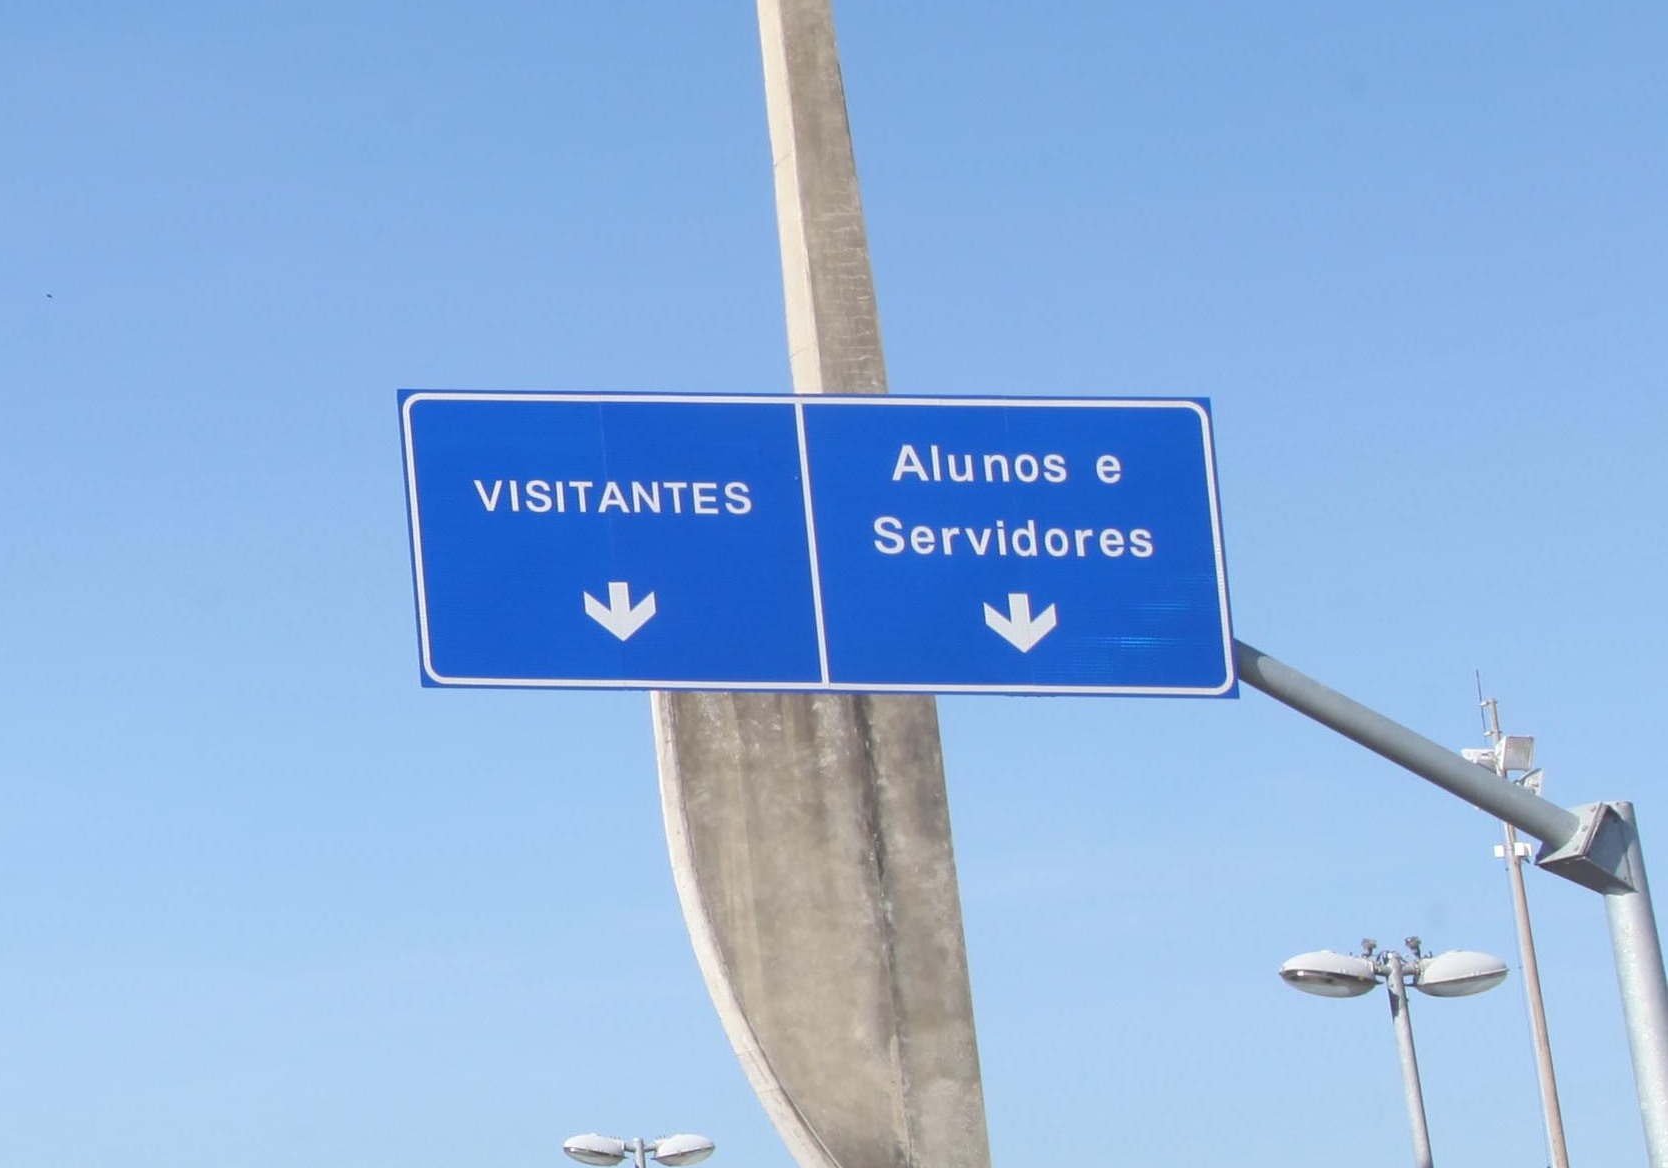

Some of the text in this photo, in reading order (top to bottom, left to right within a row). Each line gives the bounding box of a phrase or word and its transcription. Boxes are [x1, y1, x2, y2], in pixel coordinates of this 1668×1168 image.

[892, 444, 1122, 484] Alunos e
[474, 479, 753, 515] VISITANTES
[872, 516, 1154, 558] Servidores
